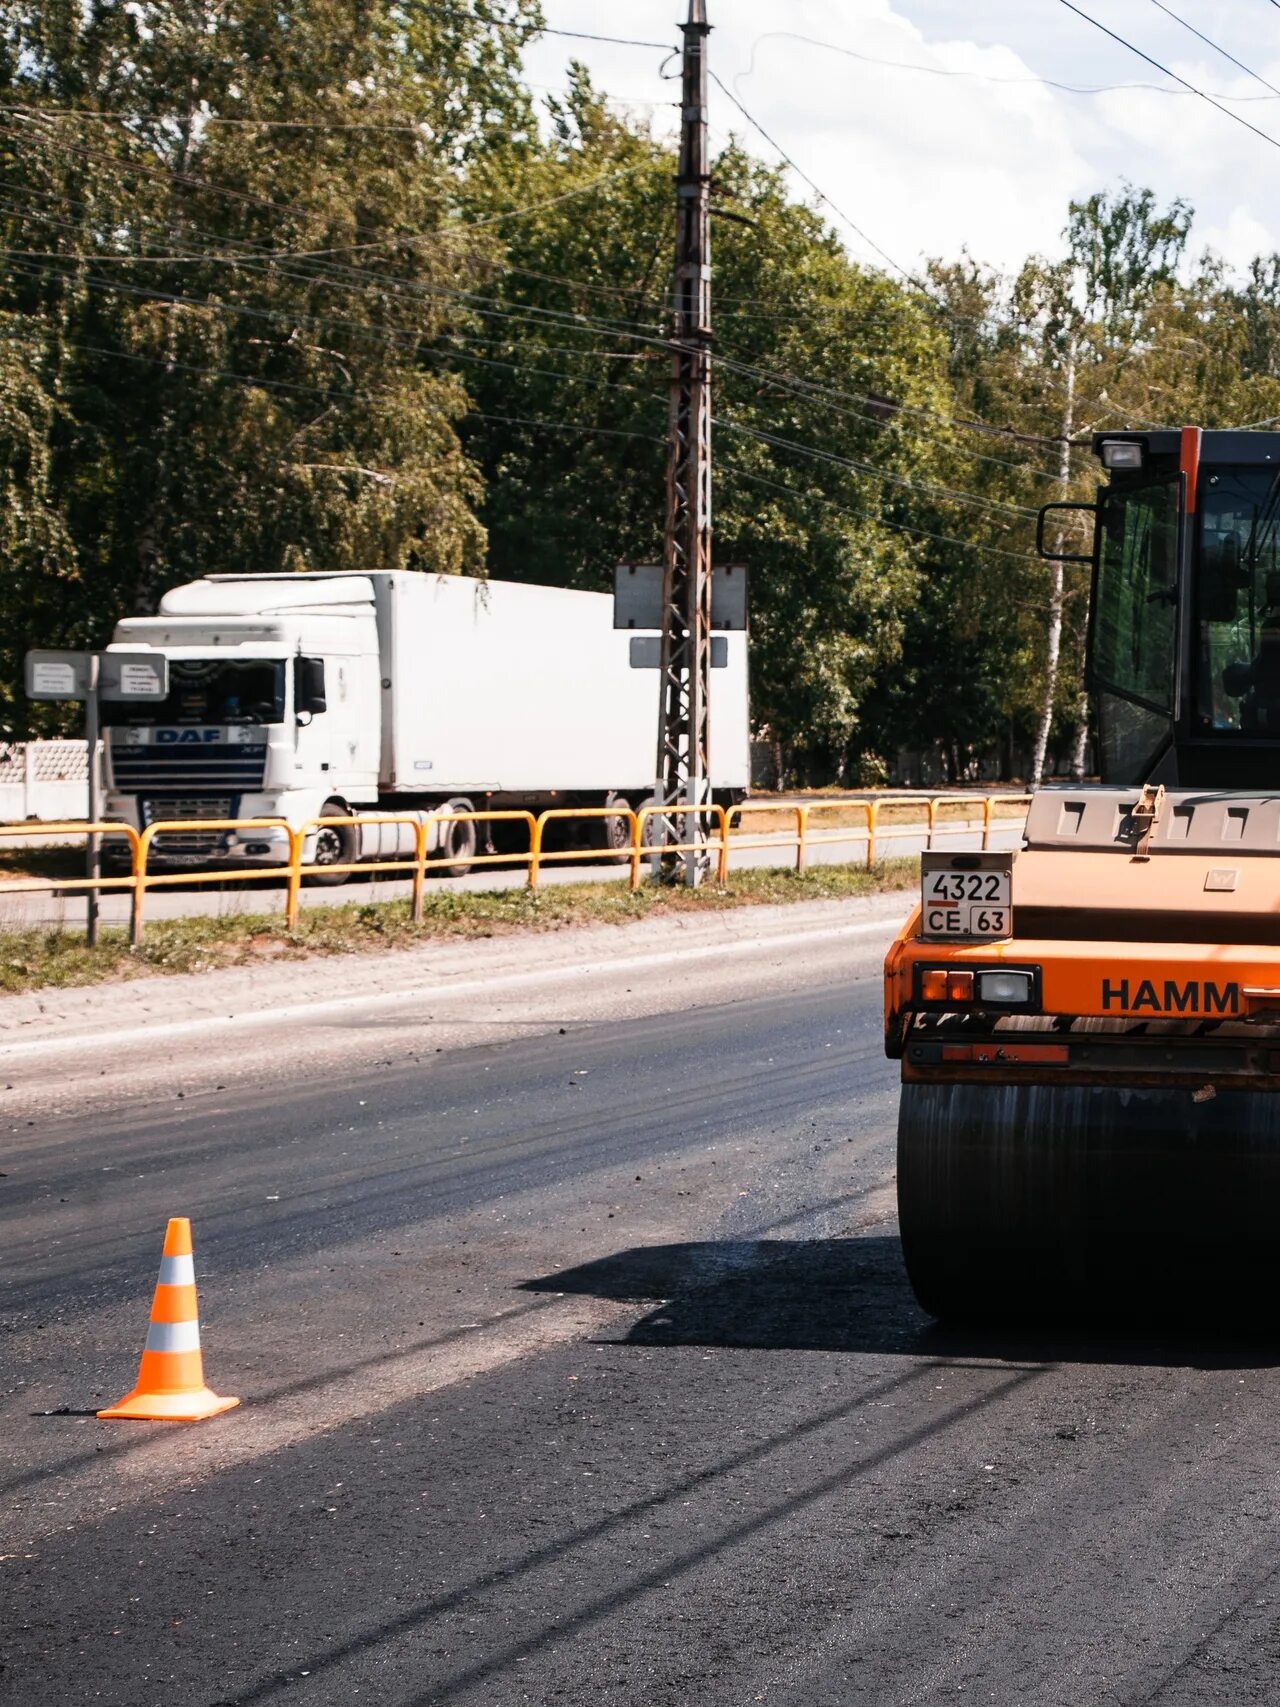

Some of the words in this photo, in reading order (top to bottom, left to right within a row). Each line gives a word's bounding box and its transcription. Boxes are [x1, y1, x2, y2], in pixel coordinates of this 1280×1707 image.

[156, 729, 220, 743] DAF
[933, 874, 1001, 901] 4322
[929, 911, 961, 931] CE
[977, 911, 1004, 931] 63
[1102, 978, 1239, 1013] HAMM
